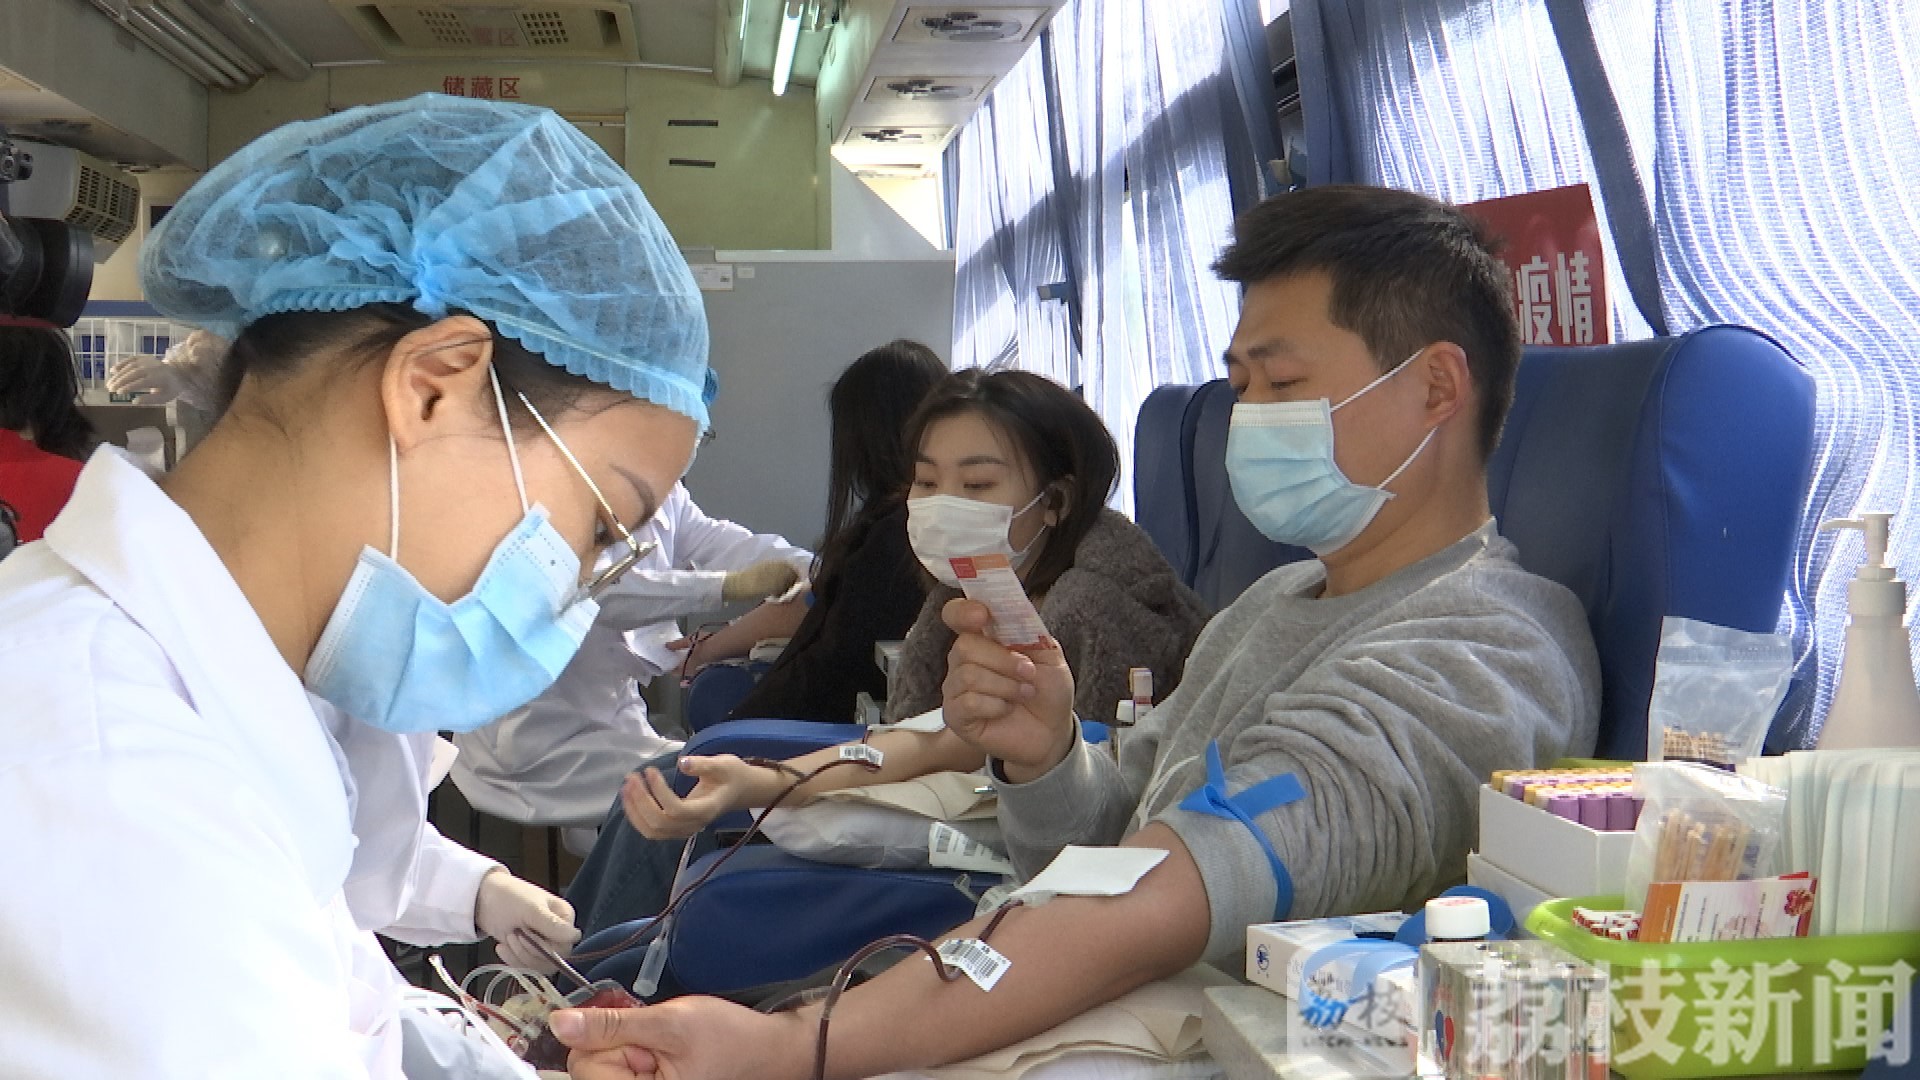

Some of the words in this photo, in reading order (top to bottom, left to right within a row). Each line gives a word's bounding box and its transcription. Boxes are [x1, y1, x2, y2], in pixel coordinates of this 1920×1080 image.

[442, 75, 521, 99] 储藏区
[1500, 251, 1594, 345] 疫情
